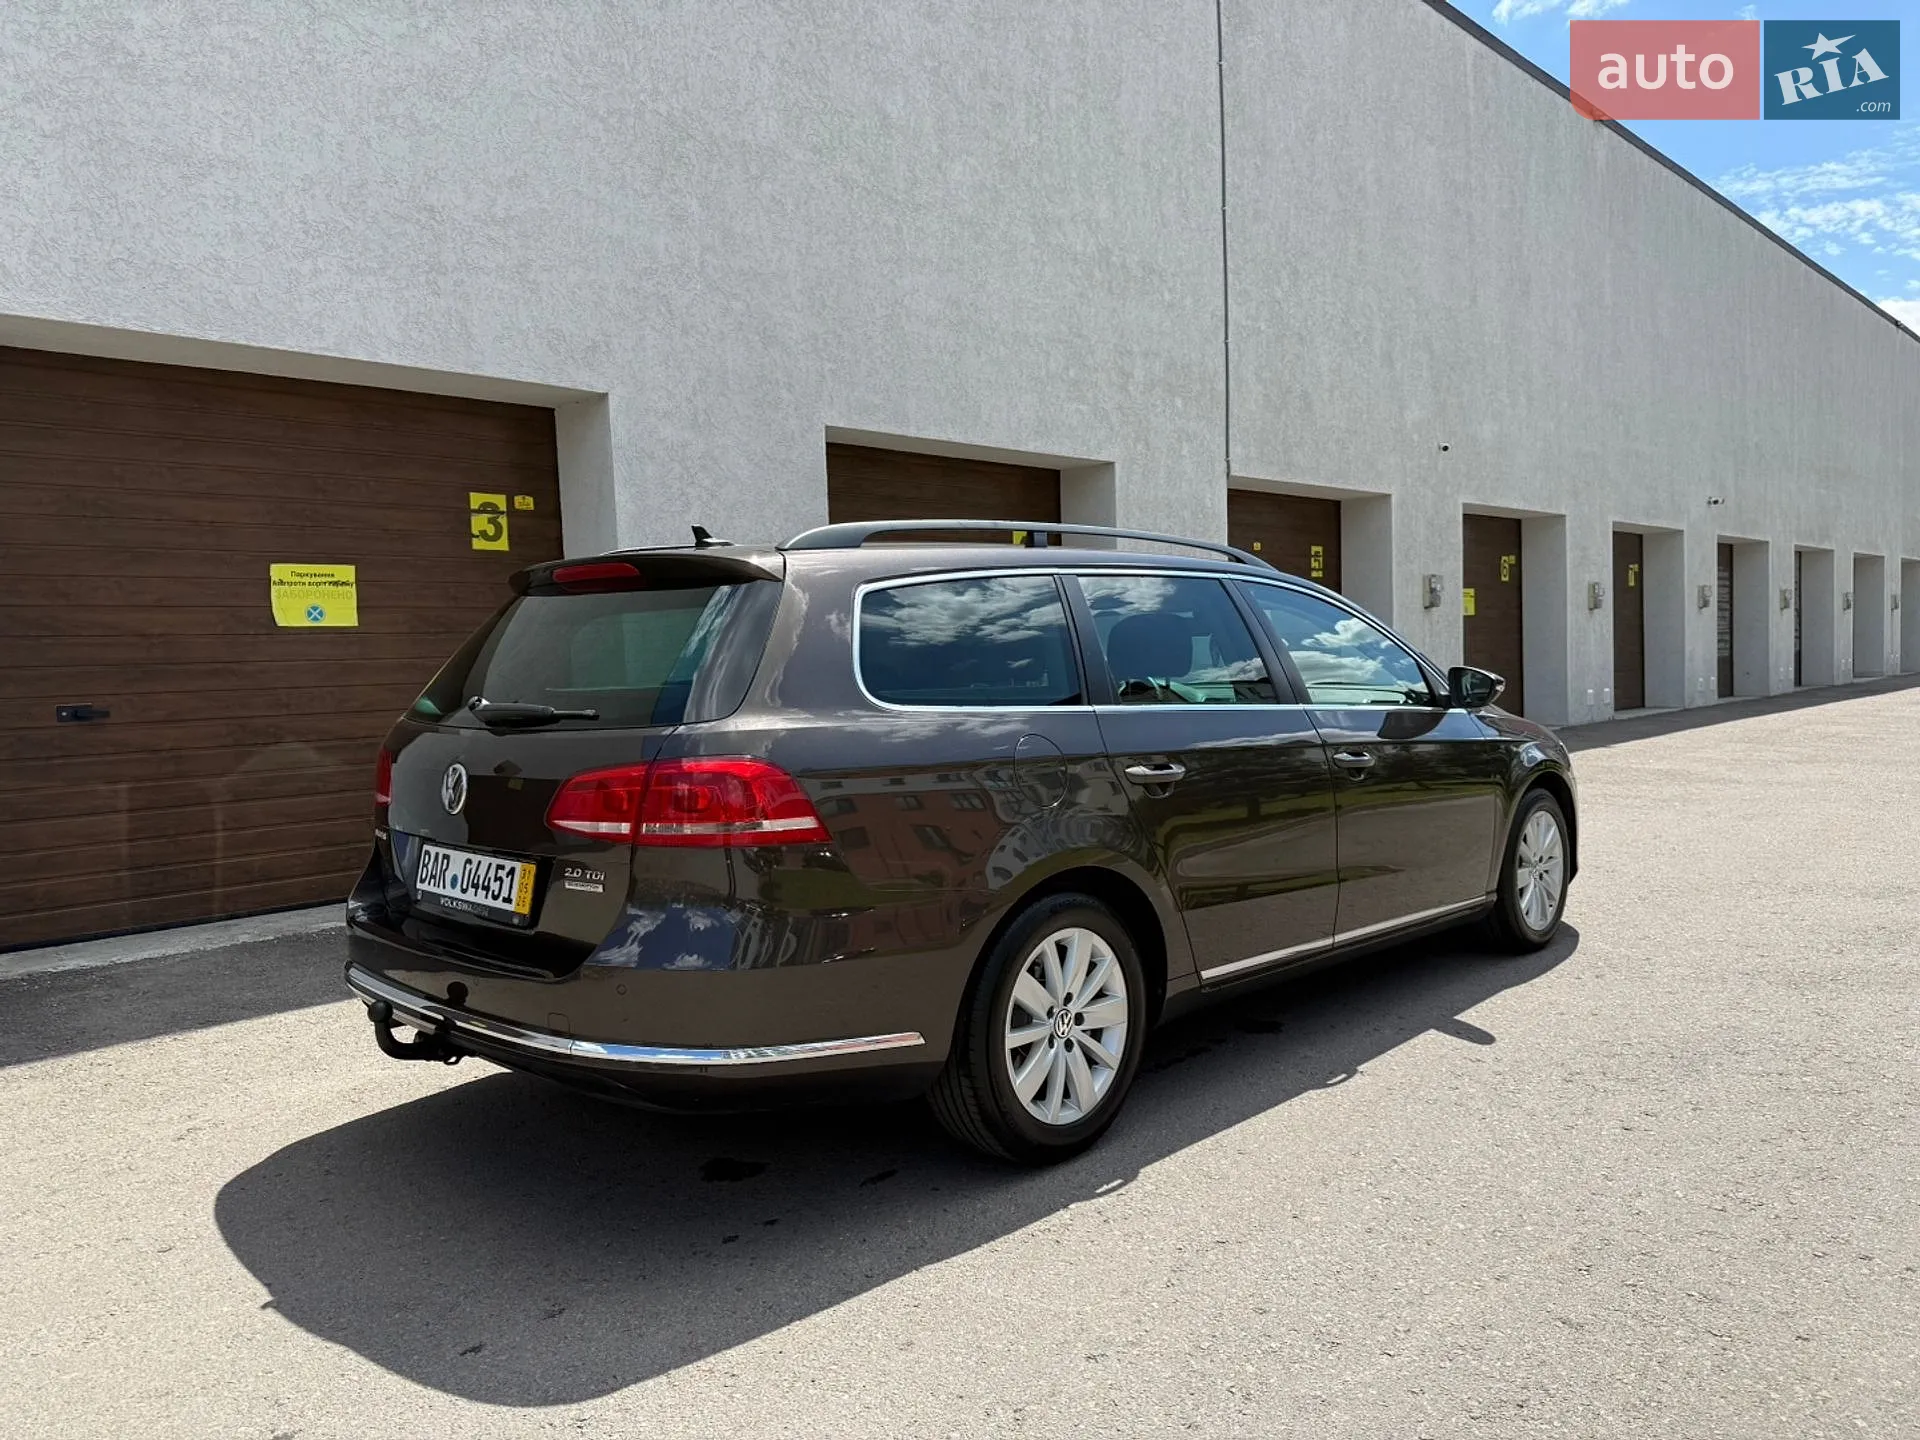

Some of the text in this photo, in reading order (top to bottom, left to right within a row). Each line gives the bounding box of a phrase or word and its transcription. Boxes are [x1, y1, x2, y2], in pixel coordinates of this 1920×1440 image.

[478, 501, 503, 542] 3
[418, 849, 516, 905] BAR 04451
